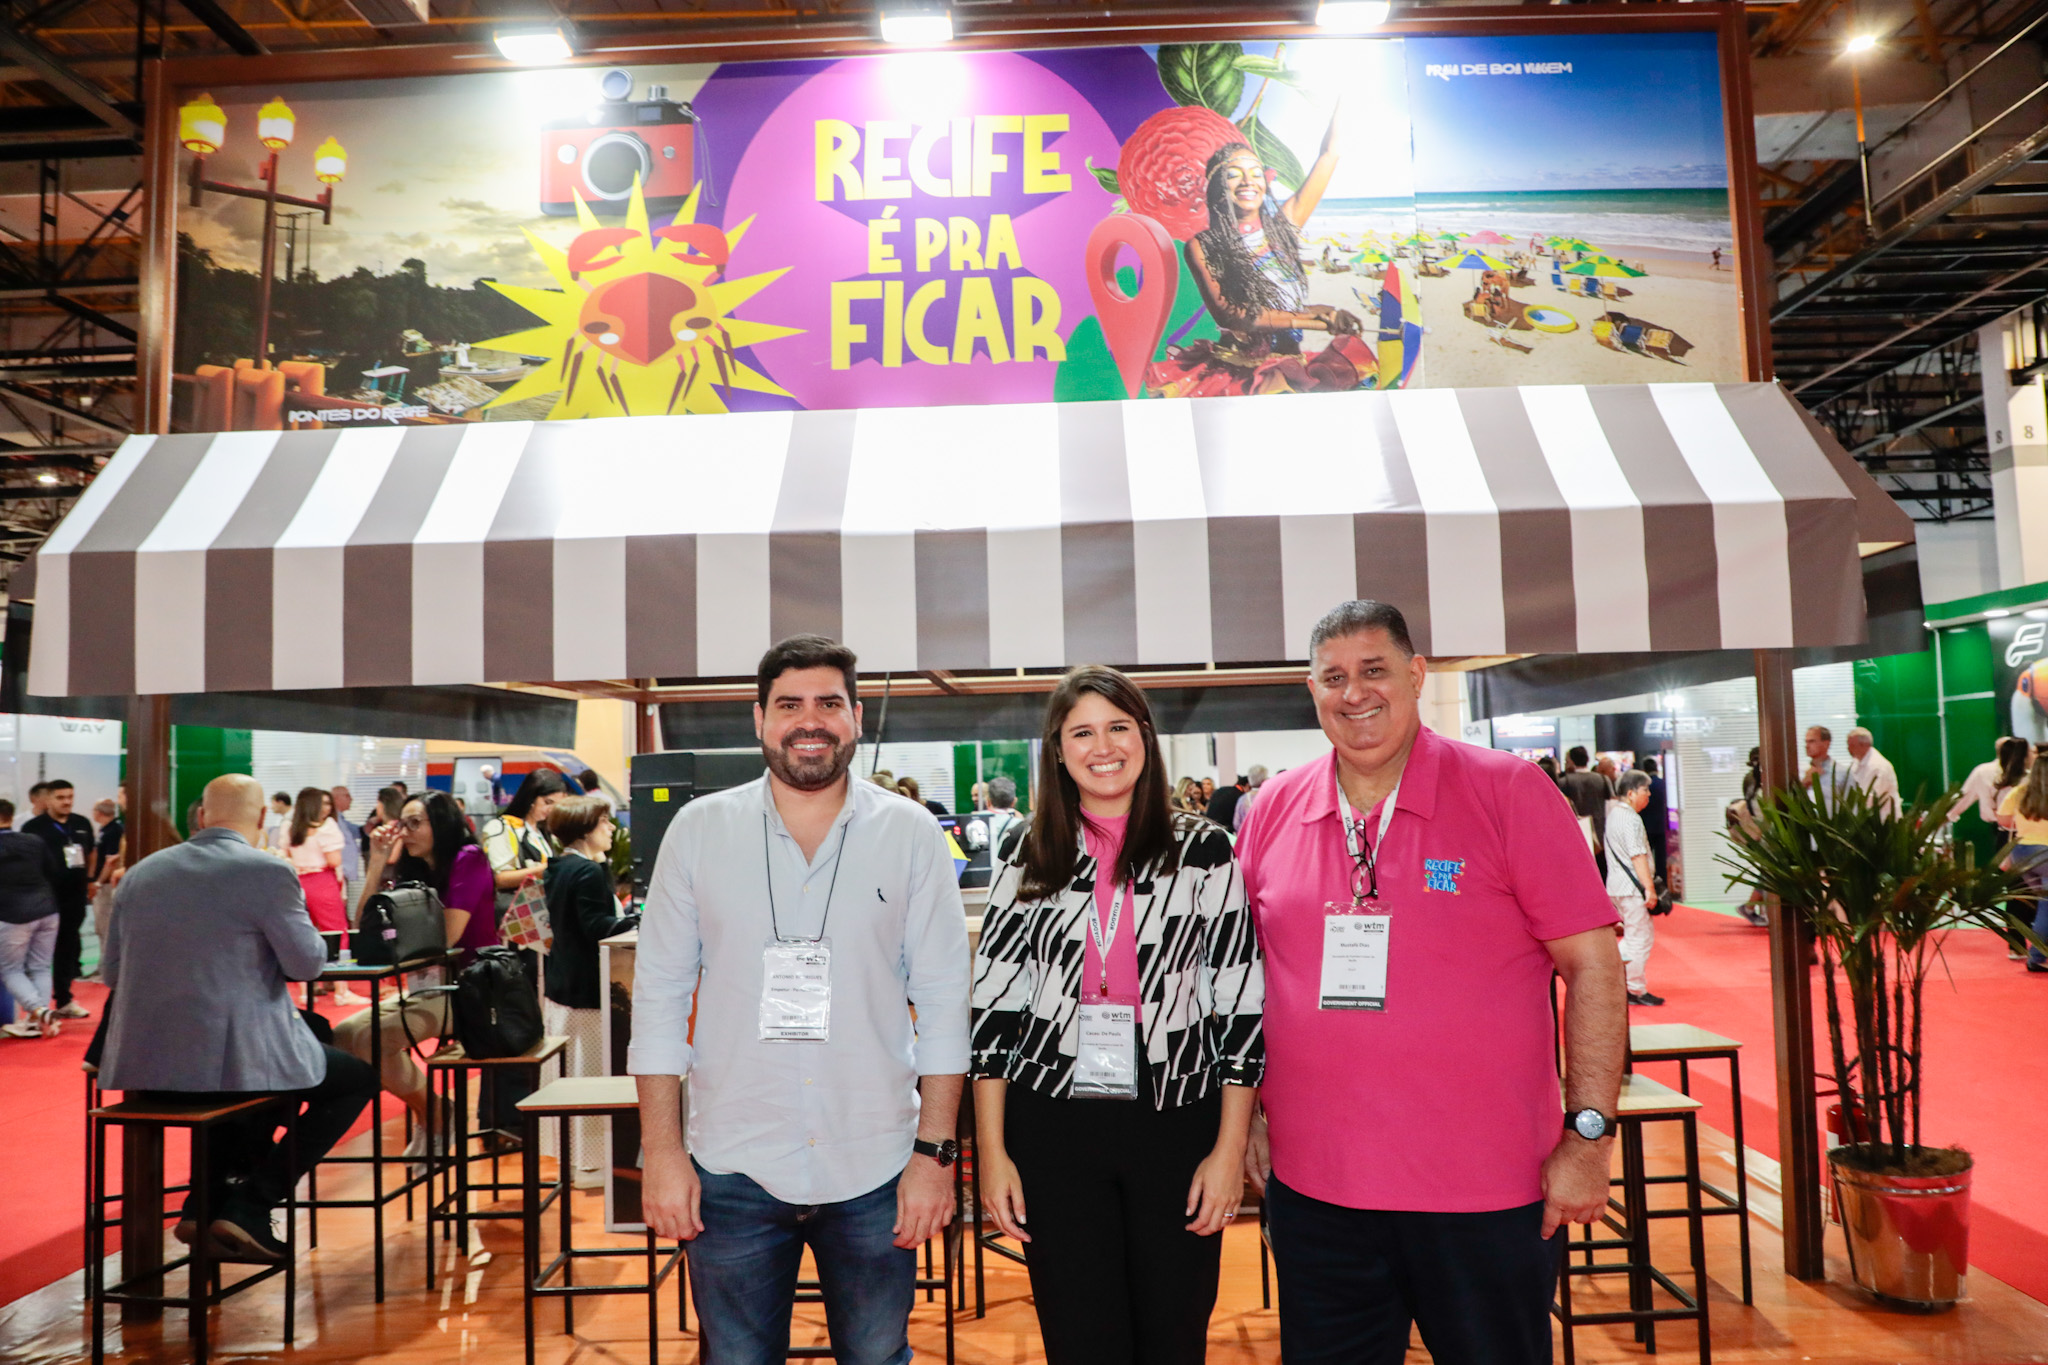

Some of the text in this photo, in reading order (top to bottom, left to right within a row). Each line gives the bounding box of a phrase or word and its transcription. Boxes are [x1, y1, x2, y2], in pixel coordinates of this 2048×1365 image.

[1461, 63, 1488, 75] DE
[1490, 62, 1522, 75] BOA
[815, 114, 1072, 201] RECIFE
[868, 205, 1023, 274] É PRA
[831, 276, 1067, 370] FICAR
[353, 408, 380, 420] DO
[1995, 430, 2003, 444] 8
[2024, 425, 2033, 439] 8
[61, 722, 105, 733] WAY
[1424, 858, 1461, 874] RECIFE
[1428, 877, 1457, 893] FICAR
